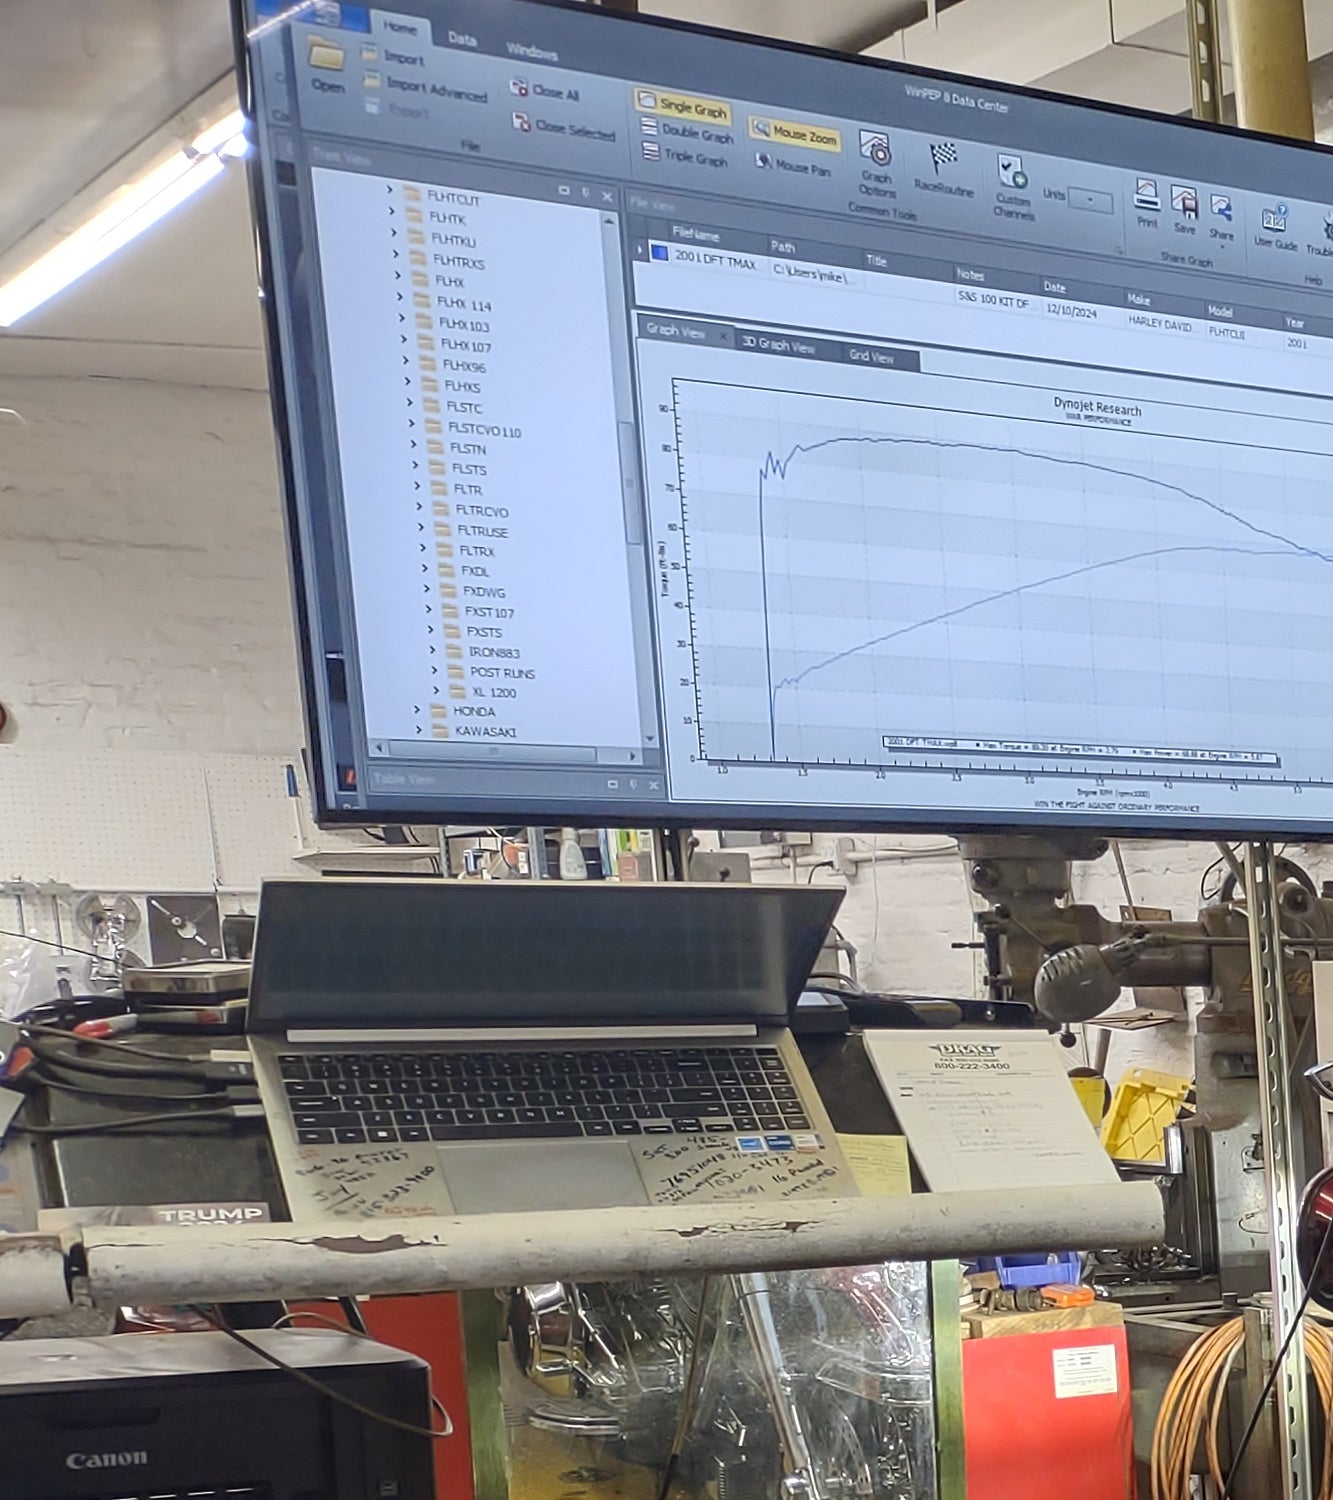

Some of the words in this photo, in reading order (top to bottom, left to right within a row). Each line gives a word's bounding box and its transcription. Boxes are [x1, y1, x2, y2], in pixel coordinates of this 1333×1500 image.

[384, 20, 417, 36] Home
[448, 31, 478, 47] Data
[385, 50, 425, 67] Import
[507, 42, 558, 61] Windows
[311, 78, 346, 94] Open
[387, 76, 426, 93] Import
[430, 84, 488, 103] Advanced
[533, 84, 563, 99] Close
[566, 89, 580, 101] All
[661, 98, 692, 114] Single
[695, 104, 727, 120] Graph
[952, 94, 975, 108] Data
[977, 99, 1009, 113] Center
[536, 119, 567, 135] Close
[569, 125, 616, 142] Selected
[663, 123, 699, 139] Double
[702, 130, 734, 145] Graph
[774, 126, 807, 141] Mouse
[810, 131, 837, 146] Zoom
[461, 139, 480, 152] File
[665, 148, 693, 164] Triple
[697, 154, 728, 169] Graph
[776, 159, 809, 175] Mouse
[811, 165, 831, 178] Pan
[862, 170, 892, 185] Graph
[859, 184, 896, 200] Options
[915, 178, 975, 198] RaceRoutine
[1043, 188, 1066, 201] Units
[996, 192, 1031, 207] Custom
[849, 201, 890, 216] Common
[893, 208, 917, 221] Tools
[993, 205, 1035, 222] Channels
[1138, 216, 1158, 229] Print
[1174, 223, 1196, 236] Save
[673, 226, 720, 243] FileName
[1210, 229, 1234, 242] Share
[772, 240, 795, 254] Path
[1255, 236, 1272, 249] User
[1275, 239, 1298, 252] Guide
[867, 254, 888, 267] Title
[1161, 251, 1186, 264] Share
[1188, 255, 1213, 269] Graph
[436, 275, 464, 288] FLHX
[957, 268, 985, 282] Notes
[1305, 274, 1323, 287] Help
[1044, 280, 1067, 294] Date
[438, 296, 466, 309] FLHX
[472, 301, 491, 312] 114
[1127, 293, 1151, 306] Make
[1047, 303, 1097, 319] 12/10/2024
[1208, 305, 1233, 318] Model
[1129, 315, 1161, 329] HARLEY
[1285, 317, 1305, 329] Year
[647, 322, 679, 337] Graph
[681, 327, 705, 340] View
[743, 336, 757, 347] 3D
[759, 338, 789, 352] Graph
[792, 342, 816, 354] View
[1287, 337, 1308, 349] 2001
[872, 352, 894, 365] View
[447, 401, 483, 414] FLSTC
[1054, 396, 1094, 412] Dynojet
[1097, 402, 1142, 417] Research
[451, 442, 486, 455] FLSTN
[453, 463, 487, 476] FLSTS
[454, 483, 482, 496] FLTR
[471, 666, 501, 679] POST
[504, 668, 535, 680] RUNS
[473, 687, 486, 697] XL
[491, 688, 517, 699] 1200
[454, 707, 496, 718] HONDA
[455, 726, 517, 738] KAWASAKI
[159, 1208, 262, 1222] TRUMP
[66, 1448, 148, 1470] Canon
